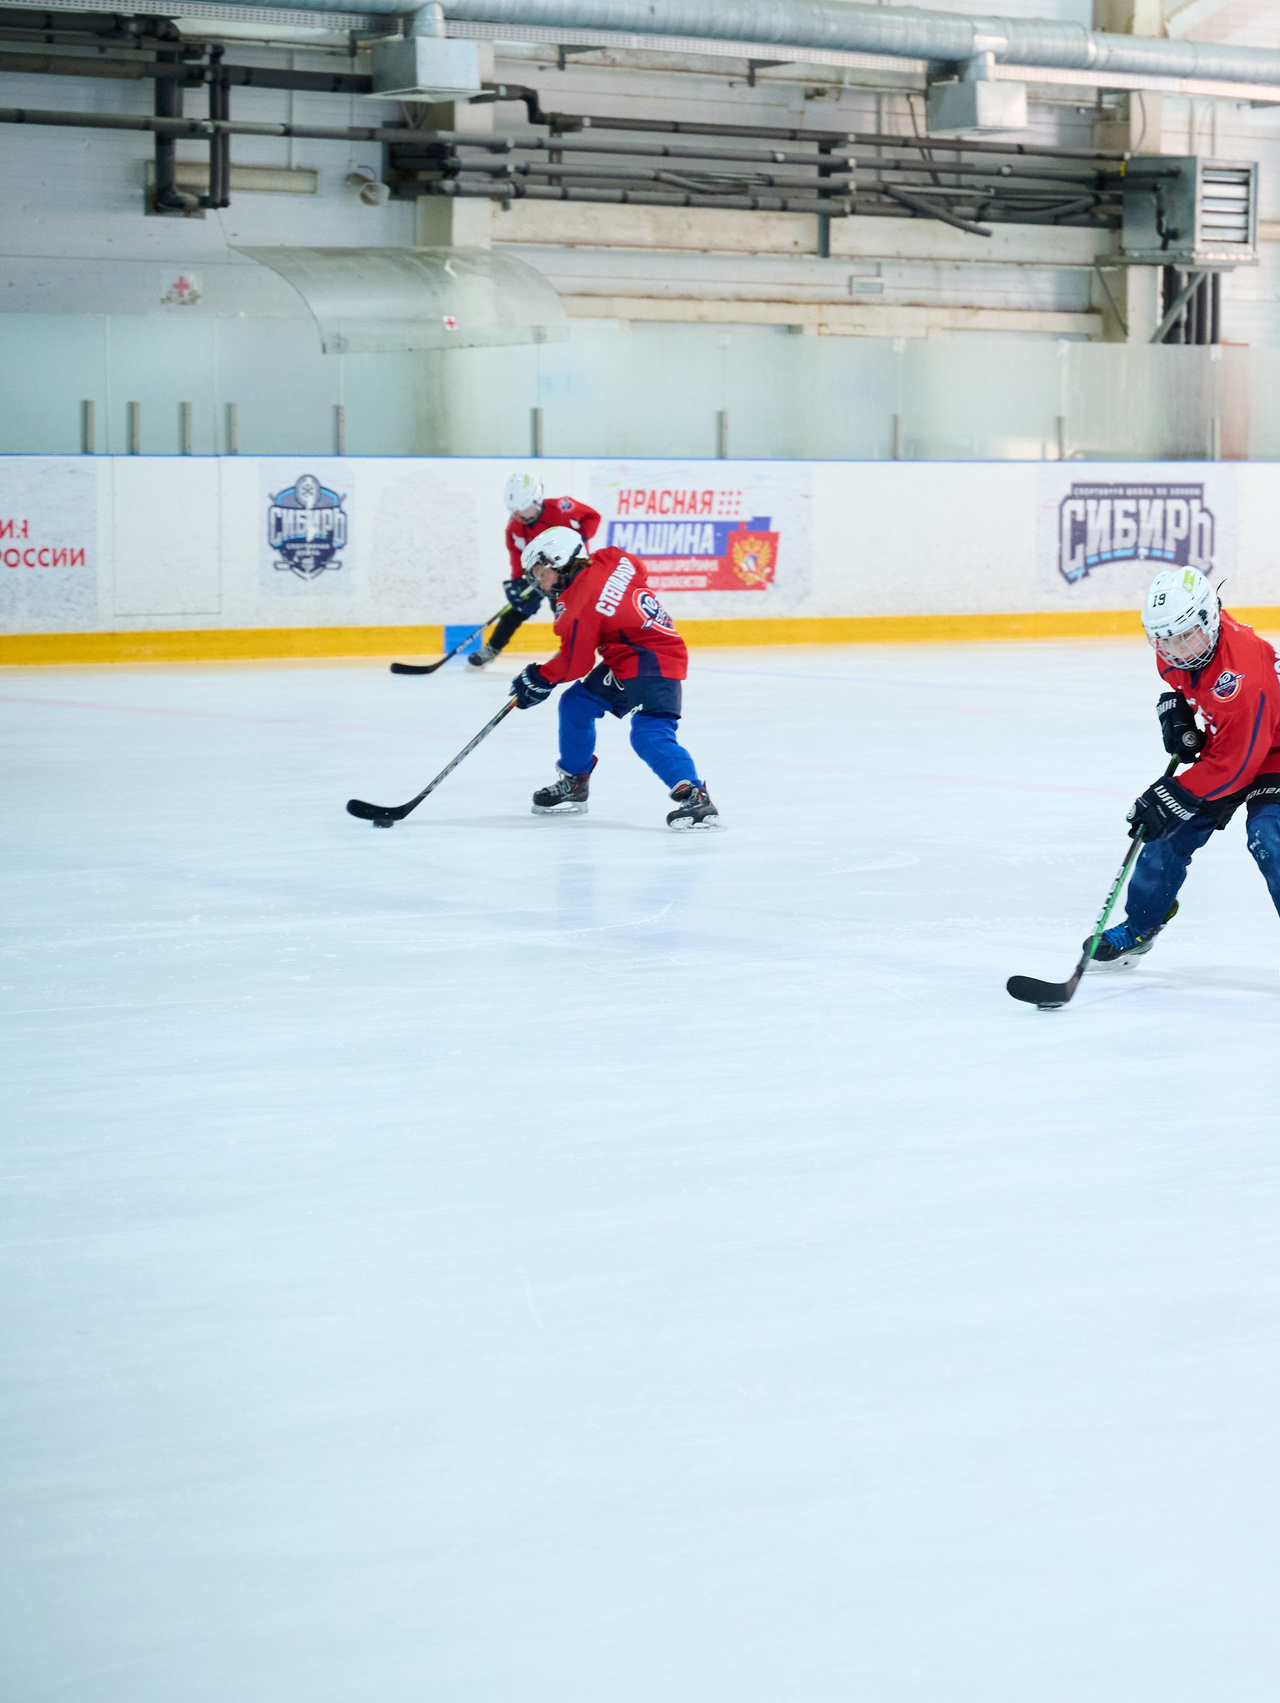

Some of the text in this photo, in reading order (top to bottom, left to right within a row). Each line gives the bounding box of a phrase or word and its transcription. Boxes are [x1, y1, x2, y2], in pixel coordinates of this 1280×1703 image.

[616, 488, 714, 516] КРАСНАЯ
[611, 522, 716, 555] МАШИНА
[1060, 498, 1213, 578] СИБИРЬ
[0, 547, 86, 569] ОССИИ
[1152, 593, 1167, 608] 19
